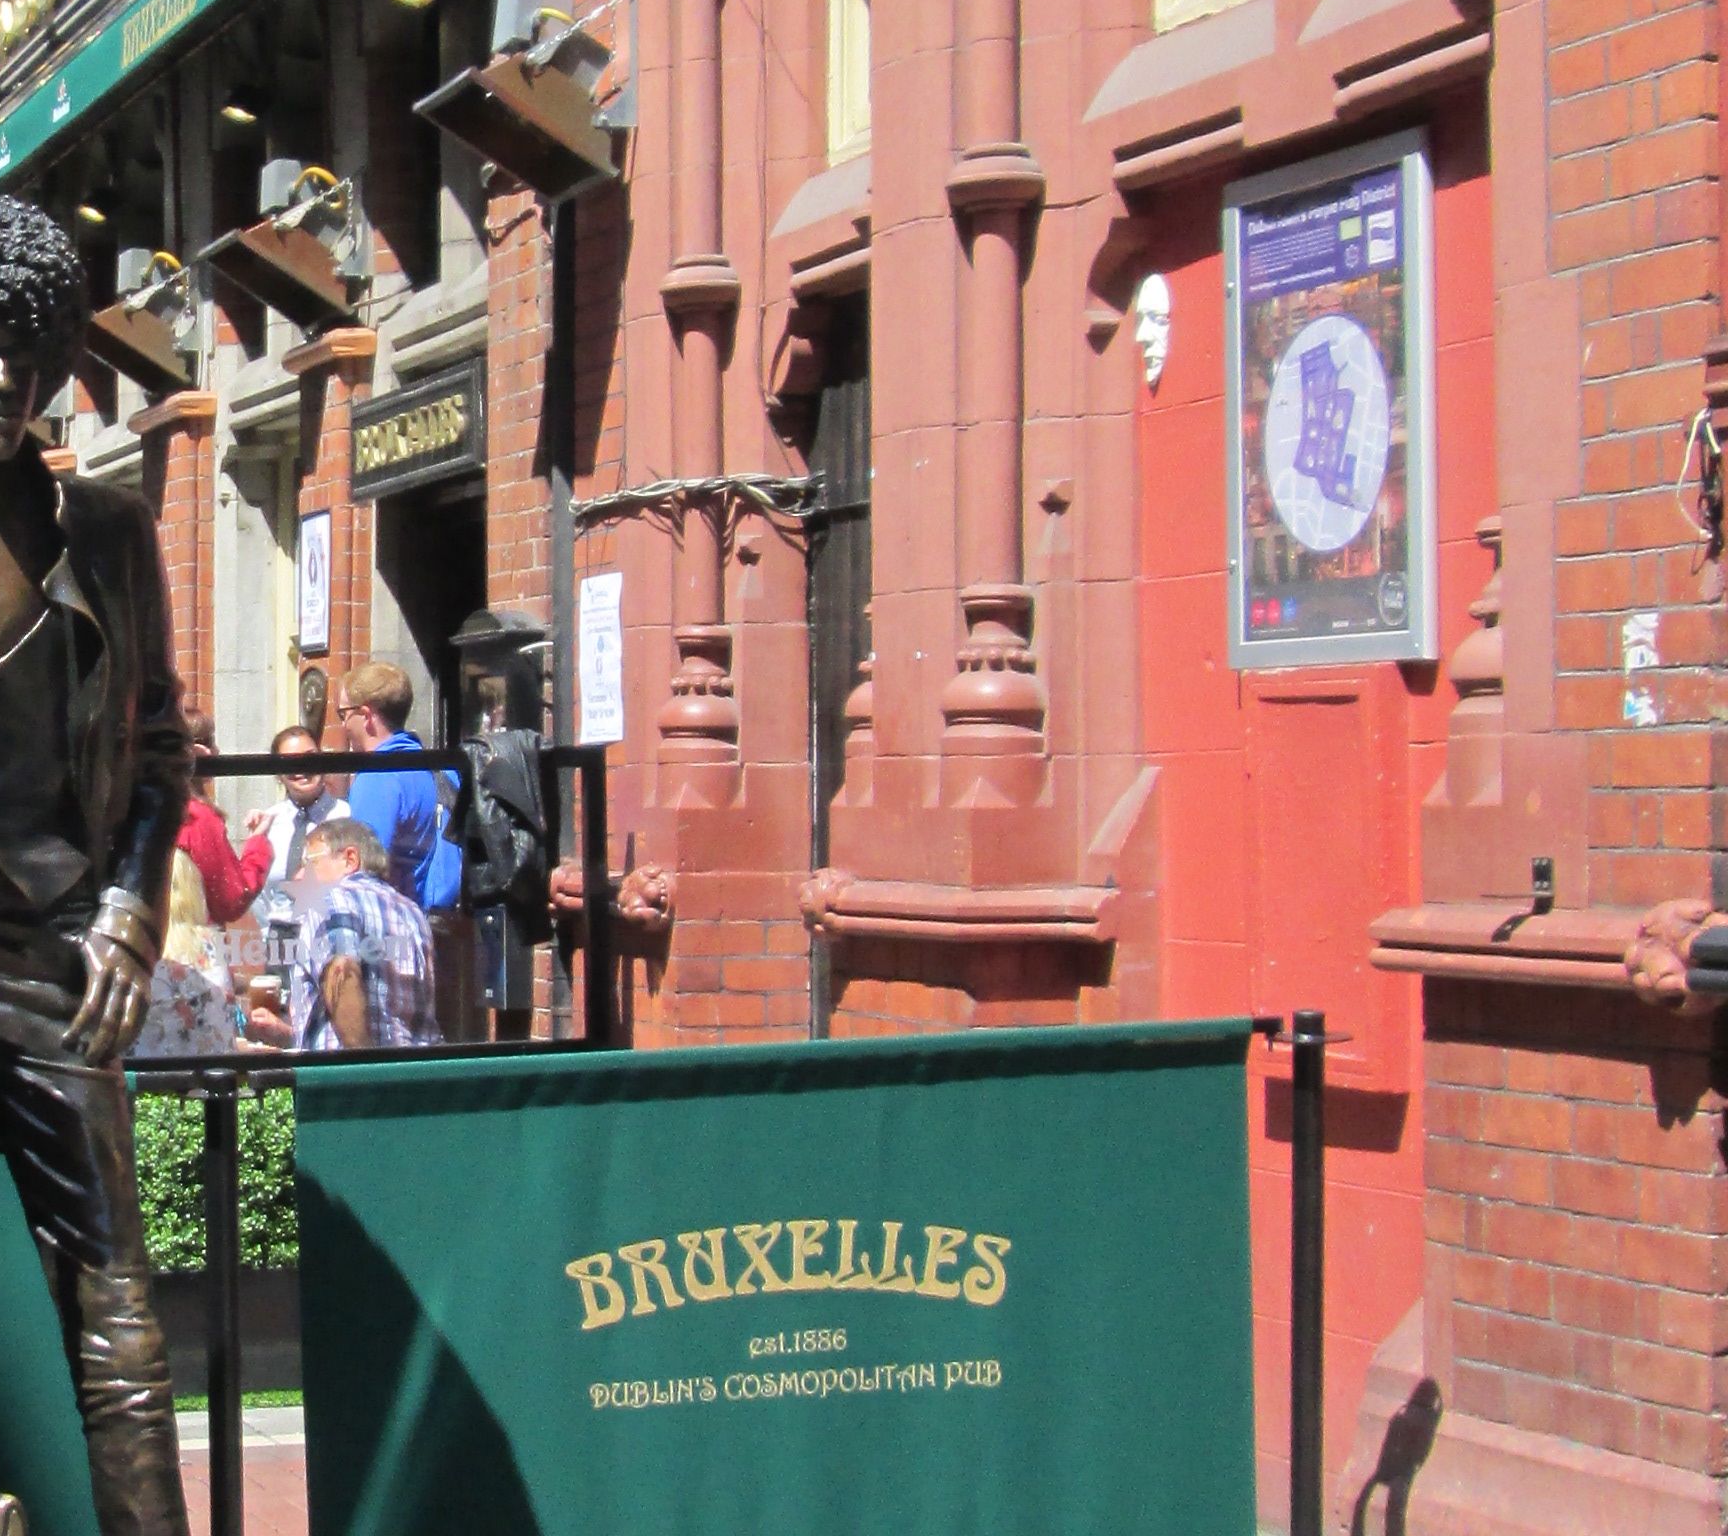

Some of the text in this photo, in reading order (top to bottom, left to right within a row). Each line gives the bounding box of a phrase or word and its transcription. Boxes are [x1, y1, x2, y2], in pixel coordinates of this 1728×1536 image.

[565, 1219, 1012, 1331] BRUXELLES
[748, 1327, 848, 1360] est.1886
[588, 1359, 1003, 1409] DUBLIN'S COSMOPOLITAN PUB
